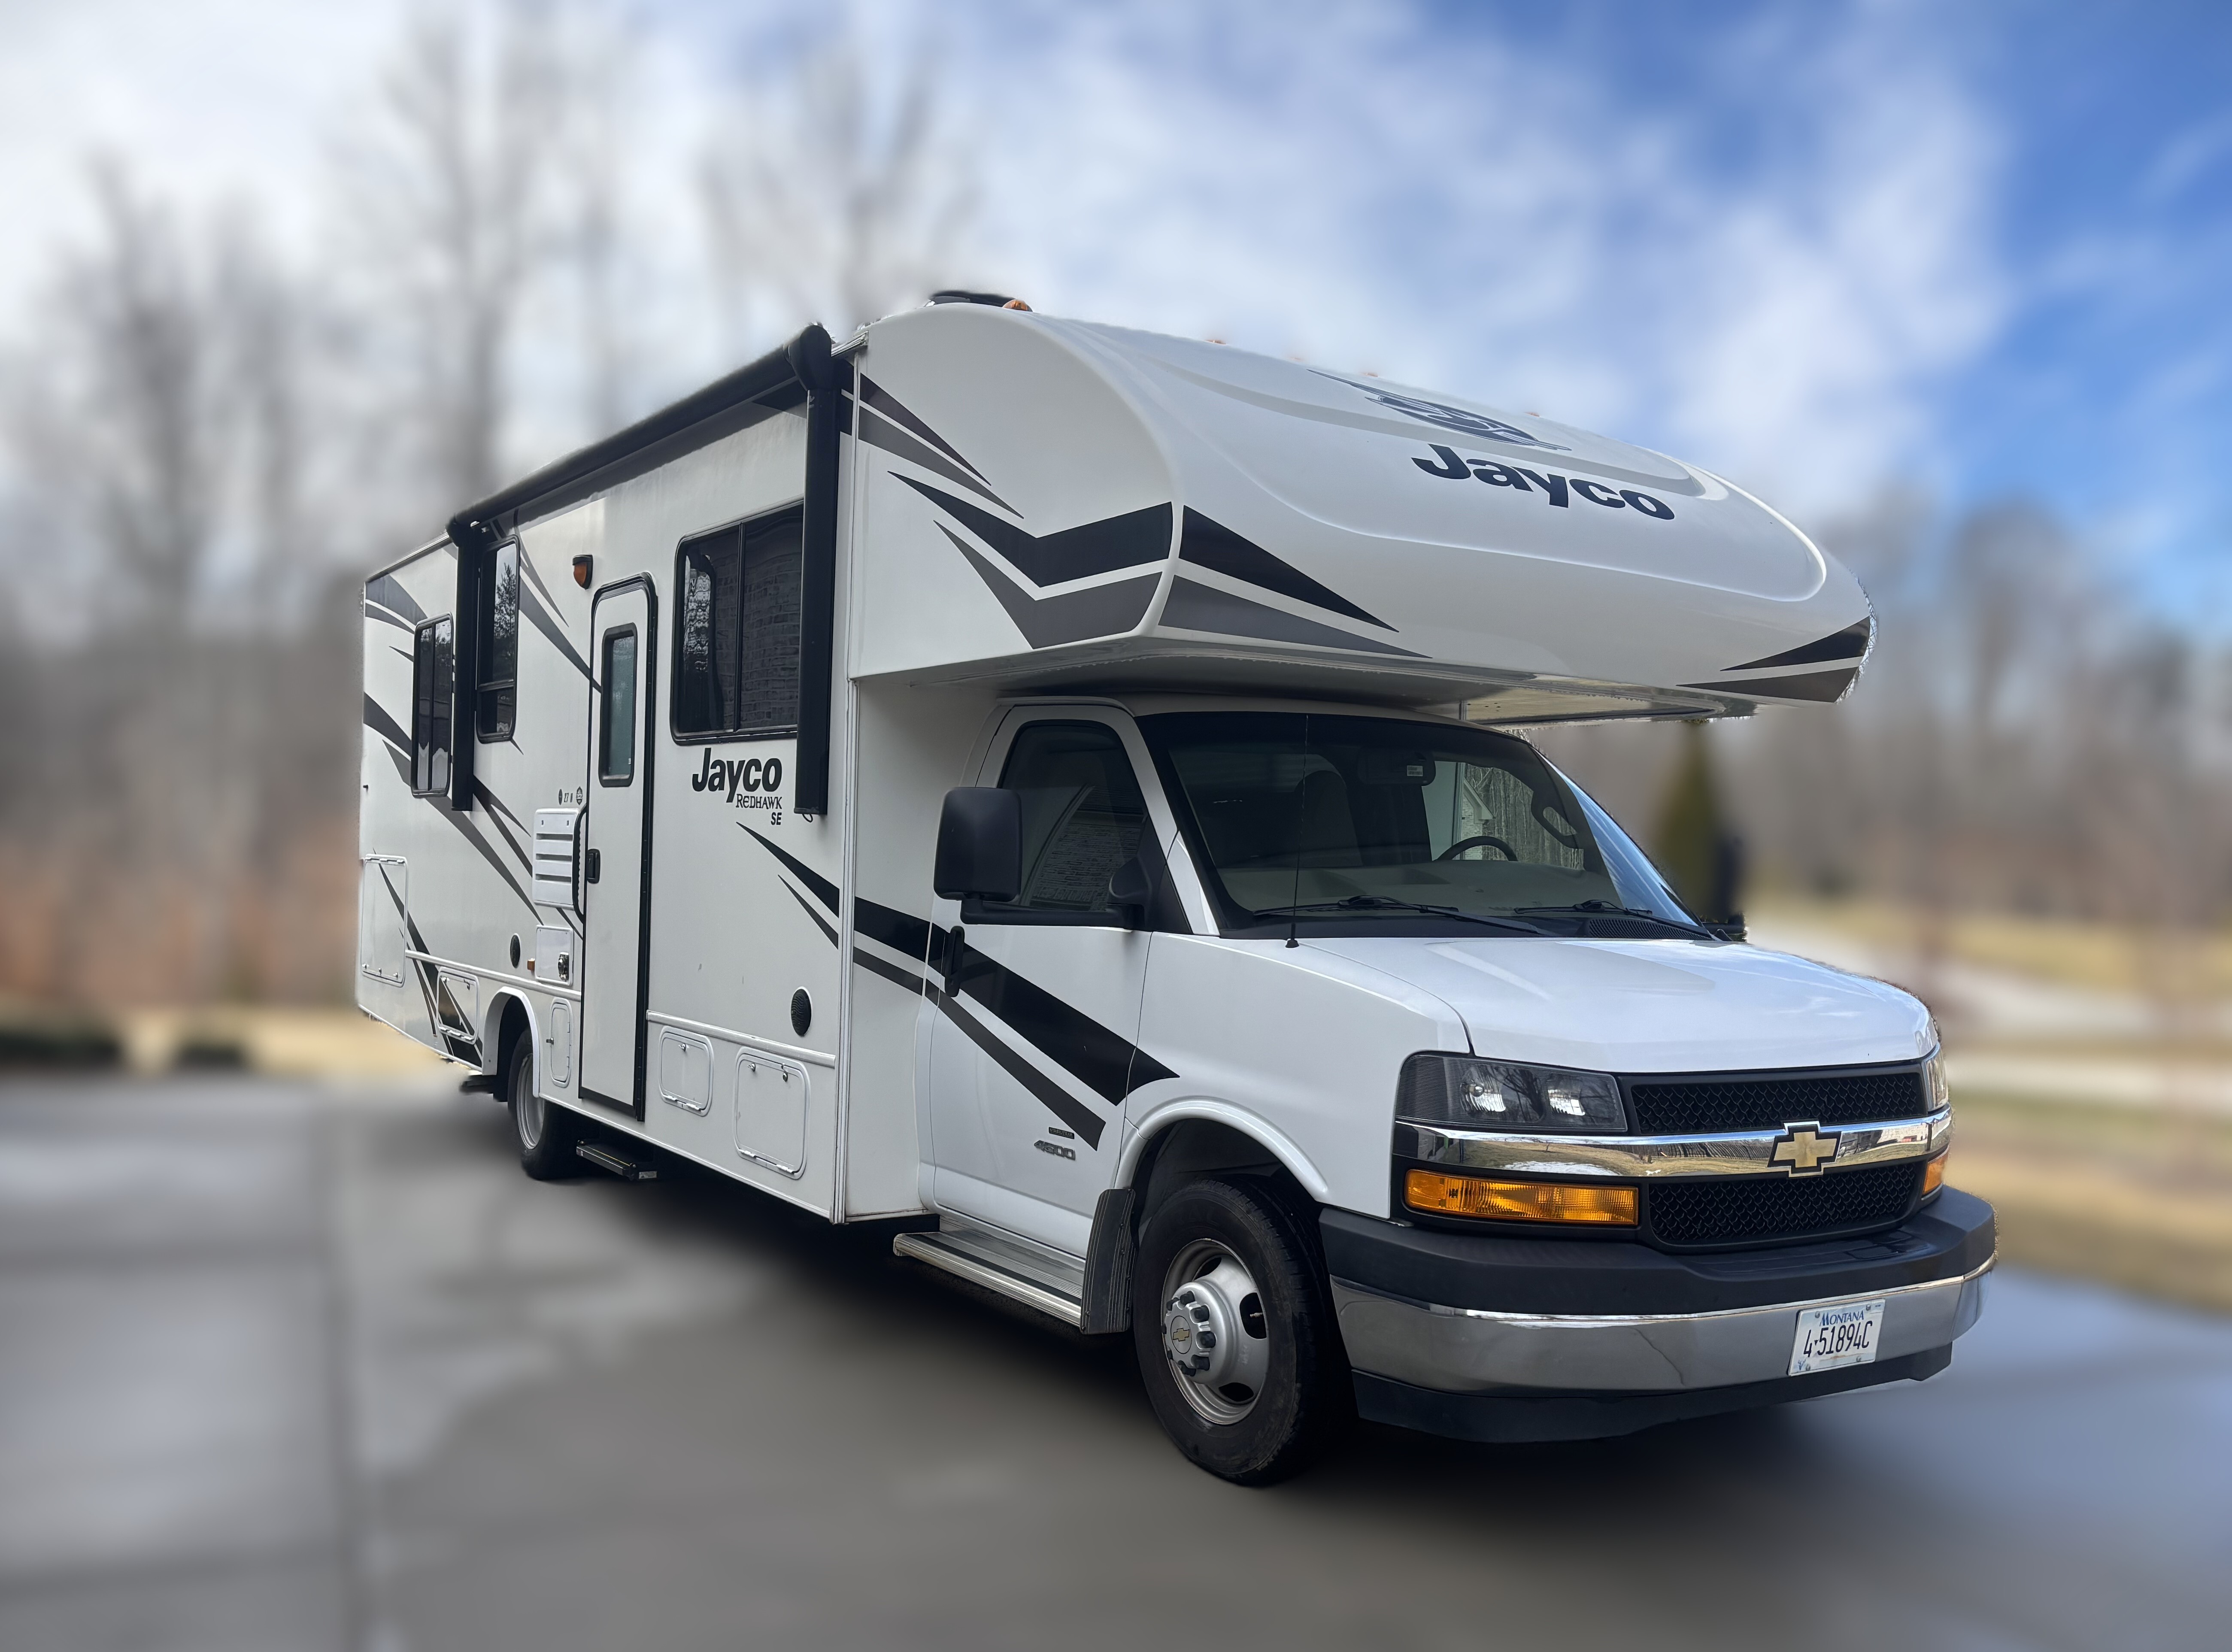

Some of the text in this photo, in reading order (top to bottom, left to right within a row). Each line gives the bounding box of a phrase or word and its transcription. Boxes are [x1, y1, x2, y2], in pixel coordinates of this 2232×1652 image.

[1411, 444, 1675, 520] Jayco
[692, 748, 782, 803] Jayco
[770, 812, 782, 825] SE
[1034, 1140, 1076, 1161] 4500
[1820, 1310, 1864, 1327] MONTANA
